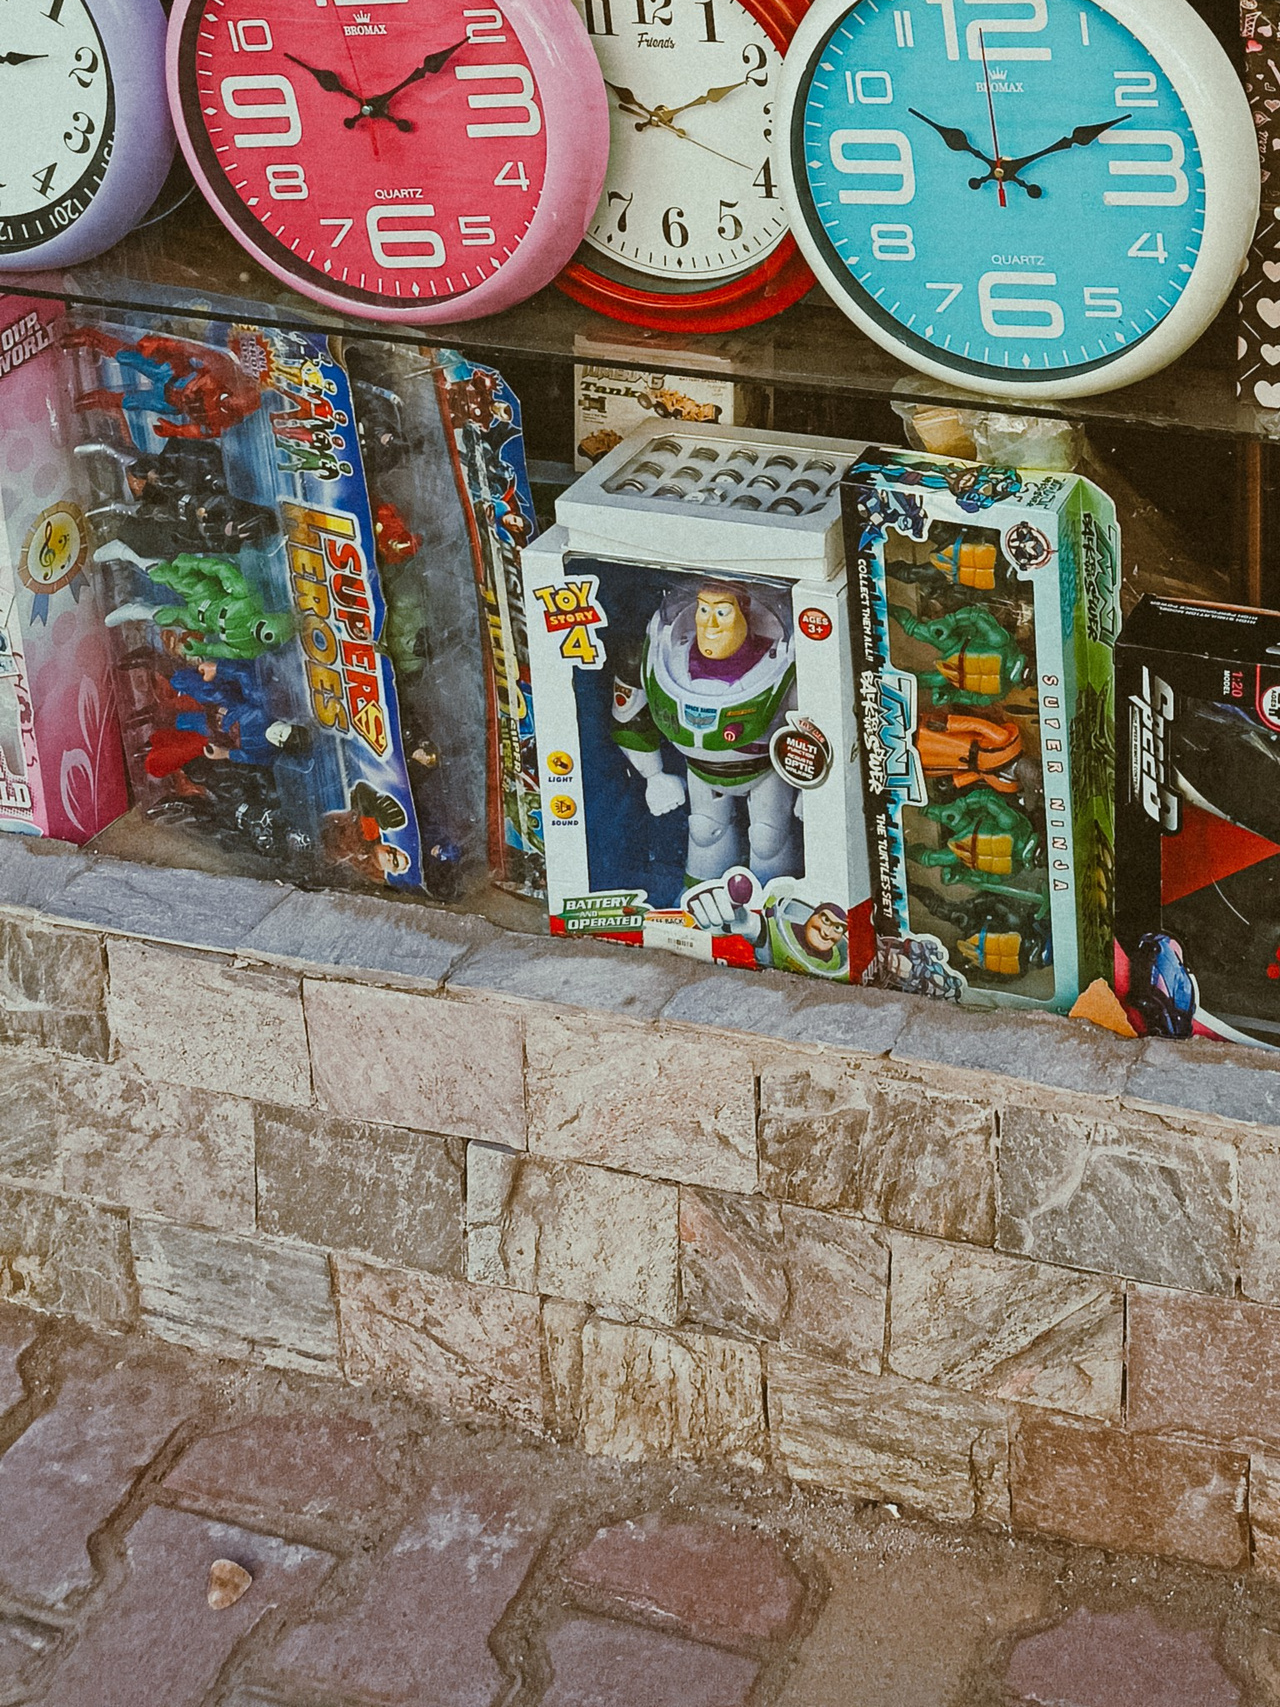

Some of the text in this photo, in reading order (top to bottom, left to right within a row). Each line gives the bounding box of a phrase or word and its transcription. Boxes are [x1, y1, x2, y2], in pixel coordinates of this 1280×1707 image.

[227, 19, 273, 53] 10
[343, 24, 388, 37] BROMAX
[463, 8, 508, 44] 2
[636, 32, 677, 51] Friends
[456, 64, 542, 139] 3
[975, 80, 1025, 94] BROMAX
[221, 74, 304, 149] 9
[266, 163, 309, 201] 8
[494, 161, 531, 193] 4
[374, 188, 424, 200] QUARTZ
[320, 217, 354, 249] 7
[366, 204, 446, 269] 6
[459, 215, 497, 248] 5
[991, 254, 1046, 267] QUARTZ
[2, 311, 42, 350] OUR
[580, 380, 638, 398] Tank
[534, 581, 592, 611] TOY
[858, 559, 872, 634] COLLECT THEM
[281, 500, 356, 734] HEROES
[326, 538, 381, 716] SUPER
[549, 610, 594, 625] STORY
[802, 614, 829, 625] AGES
[807, 623, 823, 634] 3+
[560, 625, 599, 664] 4
[1222, 669, 1231, 696] MODEL
[1231, 670, 1244, 699] 1:20
[1269, 689, 1278, 710] AGES
[786, 736, 817, 755] MULTI
[784, 757, 815, 775] OPTIC
[1041, 675, 1070, 892] SUPER NINJA
[876, 814, 893, 919] THE TURTLES SET!
[566, 896, 632, 911] BATTERY
[579, 911, 598, 919] AND
[568, 914, 643, 931] OPERATED
